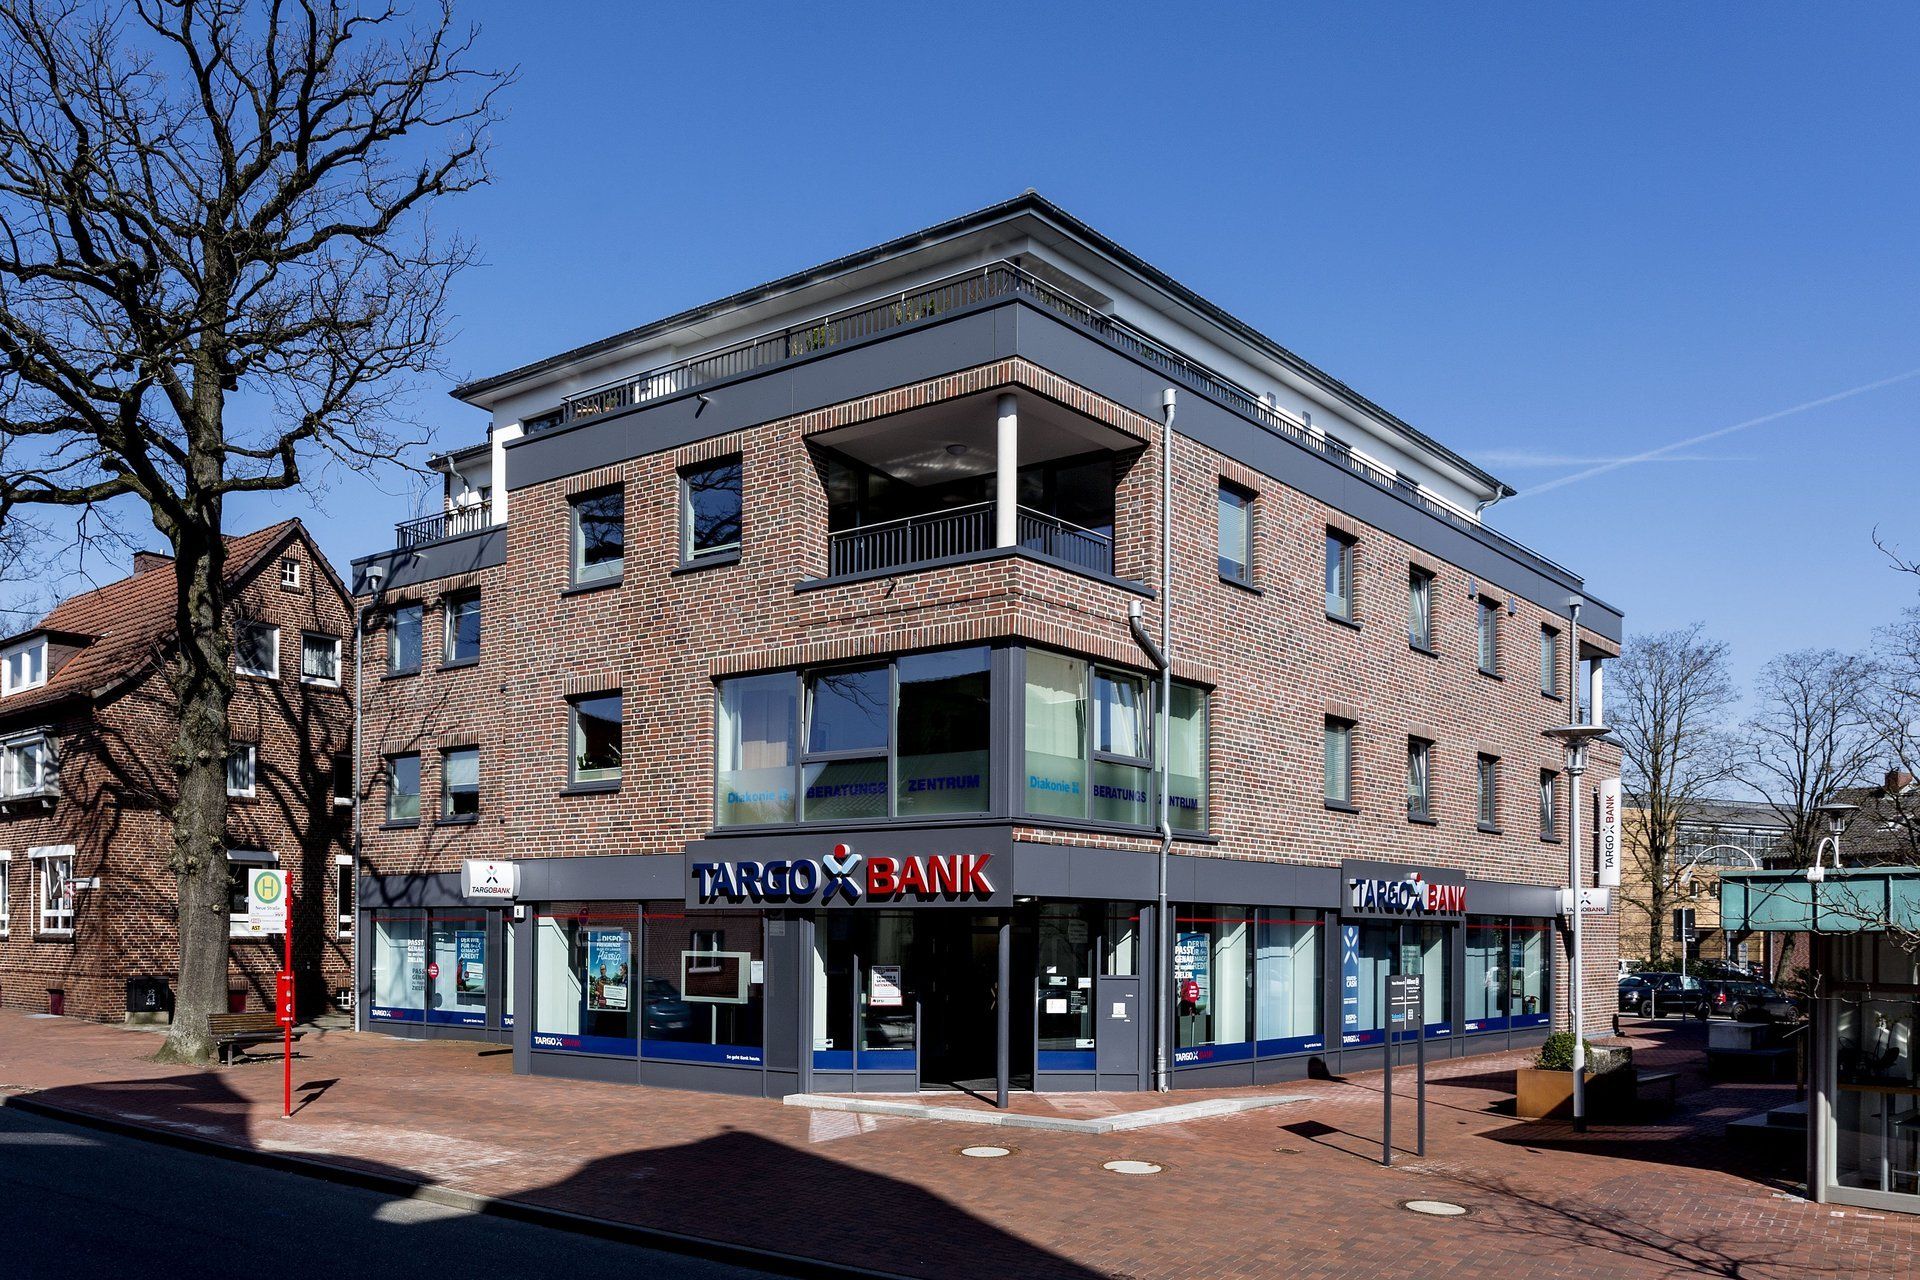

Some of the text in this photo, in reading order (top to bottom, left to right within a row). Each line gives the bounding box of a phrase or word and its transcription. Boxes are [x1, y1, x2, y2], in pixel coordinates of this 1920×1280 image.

[728, 774, 980, 806] Diakonie BERATUNGS ZENTRUM
[1030, 776, 1198, 810] Diakonie BERATUNGS ZNTRUM
[867, 853, 996, 896] BANK
[262, 879, 274, 897] H
[472, 886, 511, 894] TARGOBANK
[1175, 946, 1195, 954] PASST
[534, 1036, 556, 1046] TARGO
[1175, 1051, 1193, 1061] TARGO
